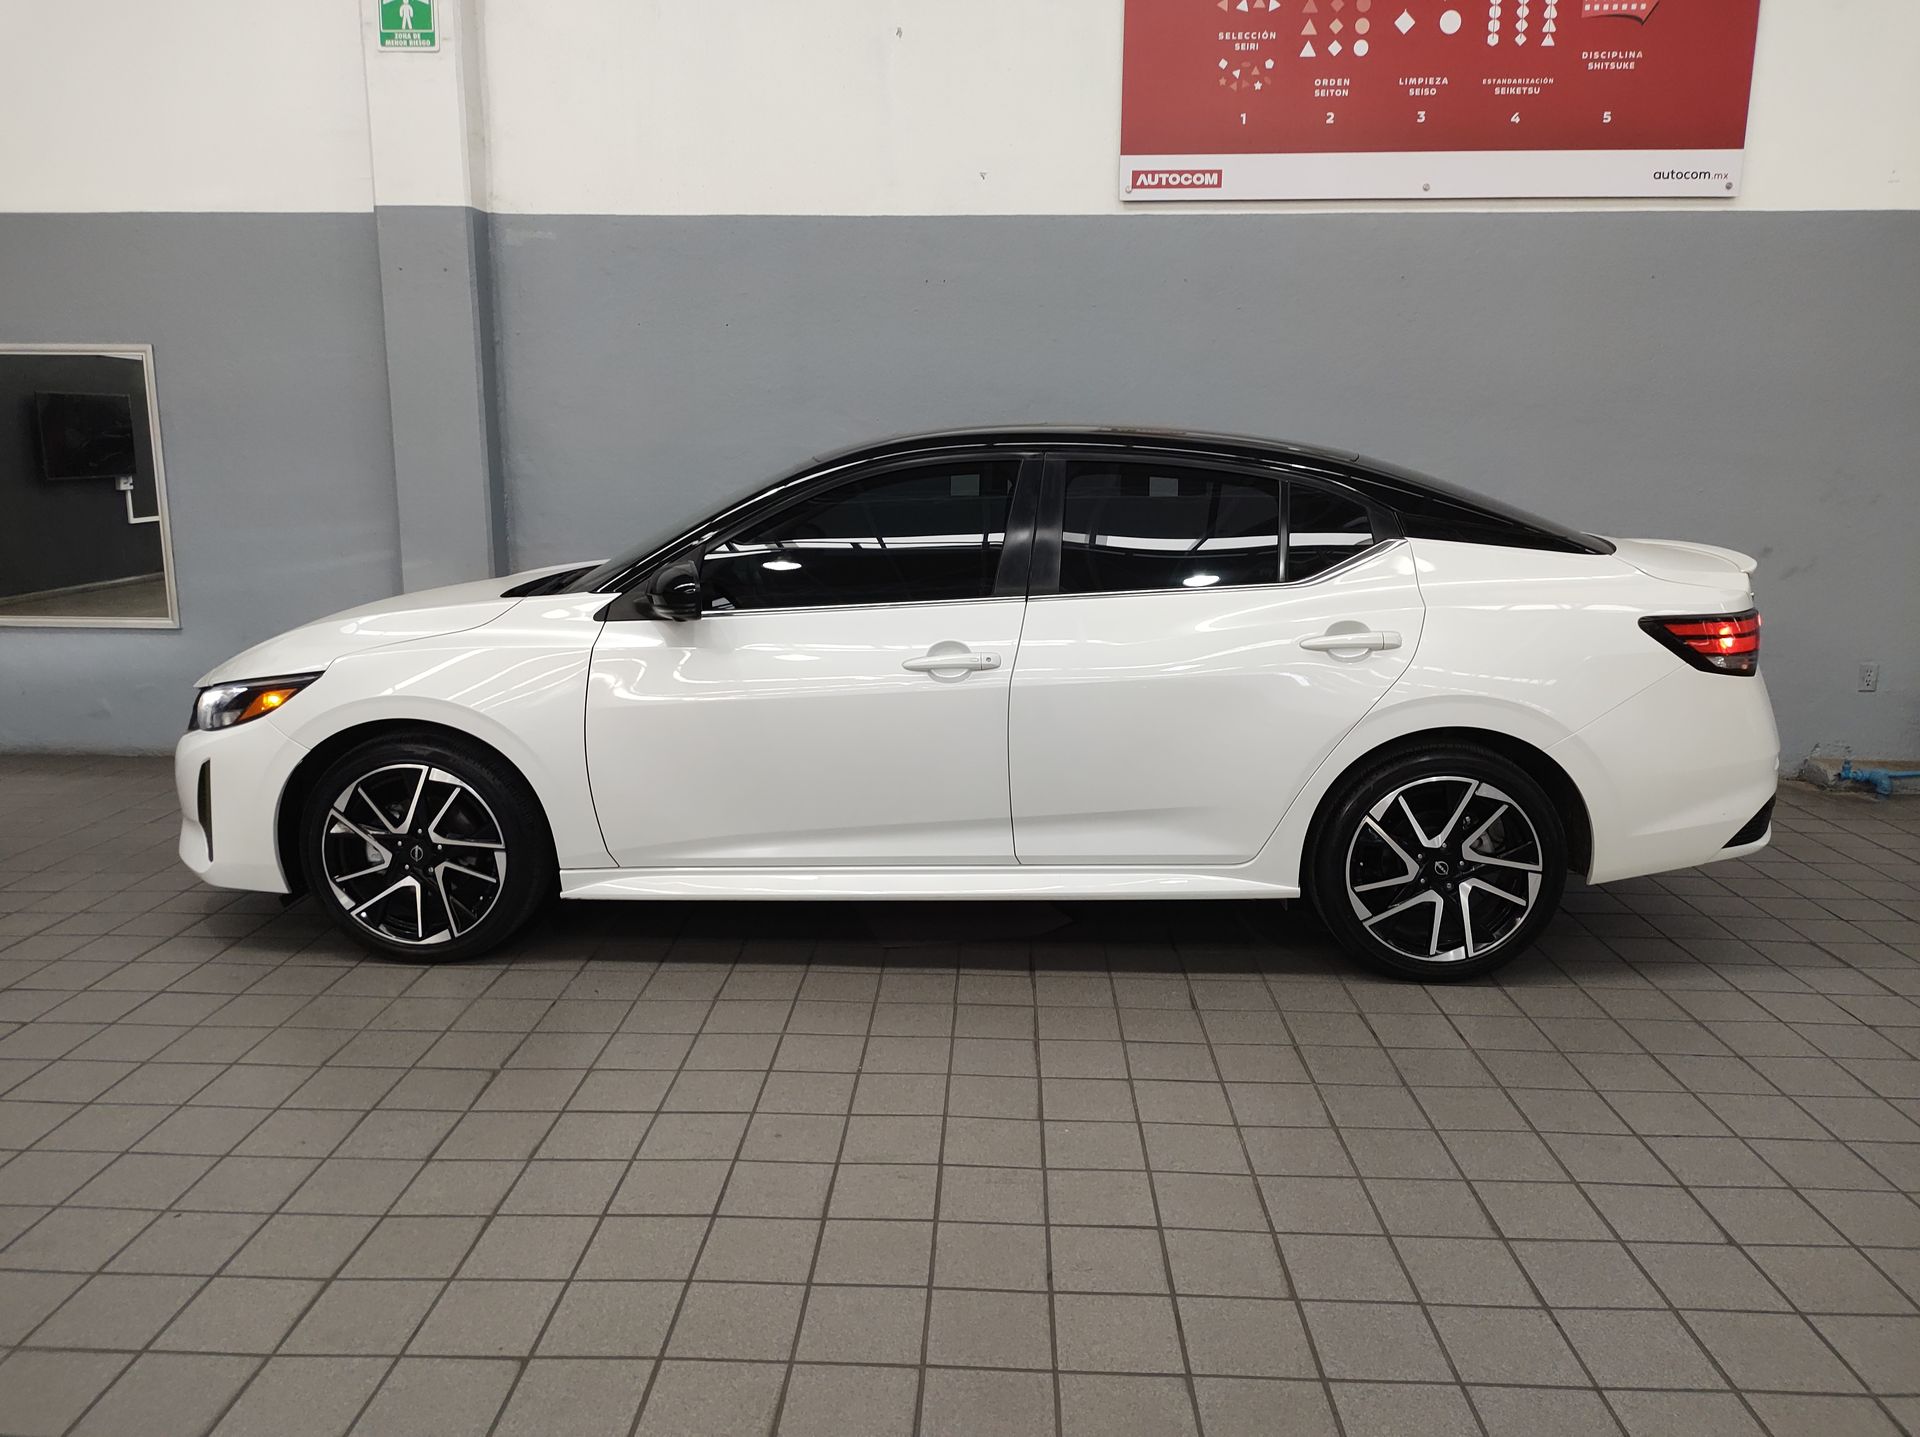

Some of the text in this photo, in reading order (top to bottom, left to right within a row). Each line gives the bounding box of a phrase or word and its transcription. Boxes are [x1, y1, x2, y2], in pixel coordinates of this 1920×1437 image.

[1218, 29, 1276, 40] SELECCIÓN
[1234, 42, 1259, 51] SEIRI
[1581, 51, 1643, 60] DISCIPLINA
[1587, 61, 1635, 70] SHITSUKE
[1314, 78, 1351, 87] ORDEN
[1398, 76, 1449, 86] LIMPIEZA
[1482, 77, 1554, 85] ESTANDARIZACIÓN
[1314, 89, 1349, 98] SEITON
[1409, 87, 1437, 97] SEISO
[1494, 86, 1541, 96] SEIKETSU
[1240, 112, 1247, 125] 1
[1325, 111, 1335, 124] 2
[1416, 110, 1426, 123] 3
[1510, 112, 1521, 124] 4
[1602, 111, 1612, 123] 5
[1136, 173, 1218, 186] AUTOCOM
[1653, 169, 1729, 180] autocom.mx
